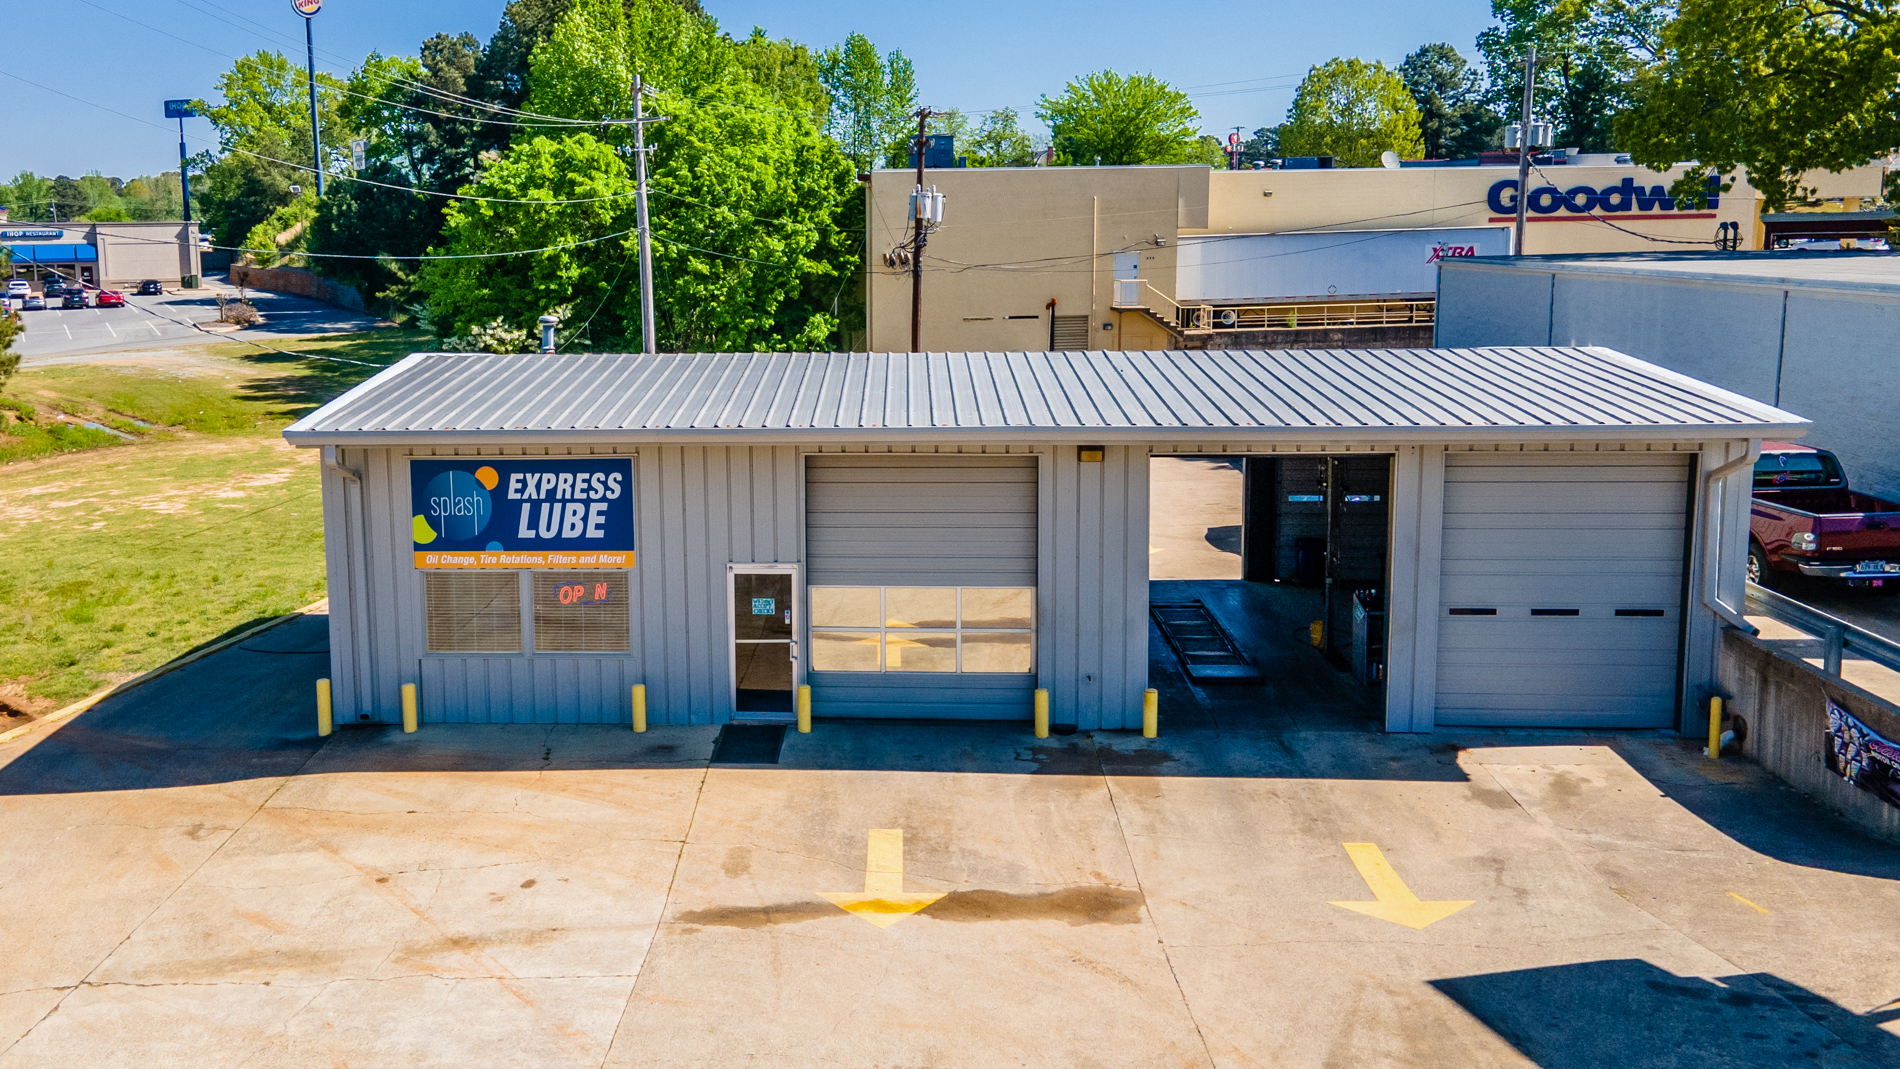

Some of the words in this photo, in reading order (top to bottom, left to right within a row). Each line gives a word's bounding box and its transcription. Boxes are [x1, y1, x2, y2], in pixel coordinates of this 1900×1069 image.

[1487, 175, 1721, 215] Goodwl
[430, 470, 484, 538] splash
[507, 472, 623, 500] EXPRESS
[517, 502, 609, 539] LUBE
[426, 554, 439, 564] Oil
[440, 554, 477, 566] Change,
[480, 554, 497, 564] Tire
[499, 554, 546, 566] Rotations,
[547, 554, 577, 564] Filters
[579, 554, 597, 564] and
[598, 554, 626, 564] More!
